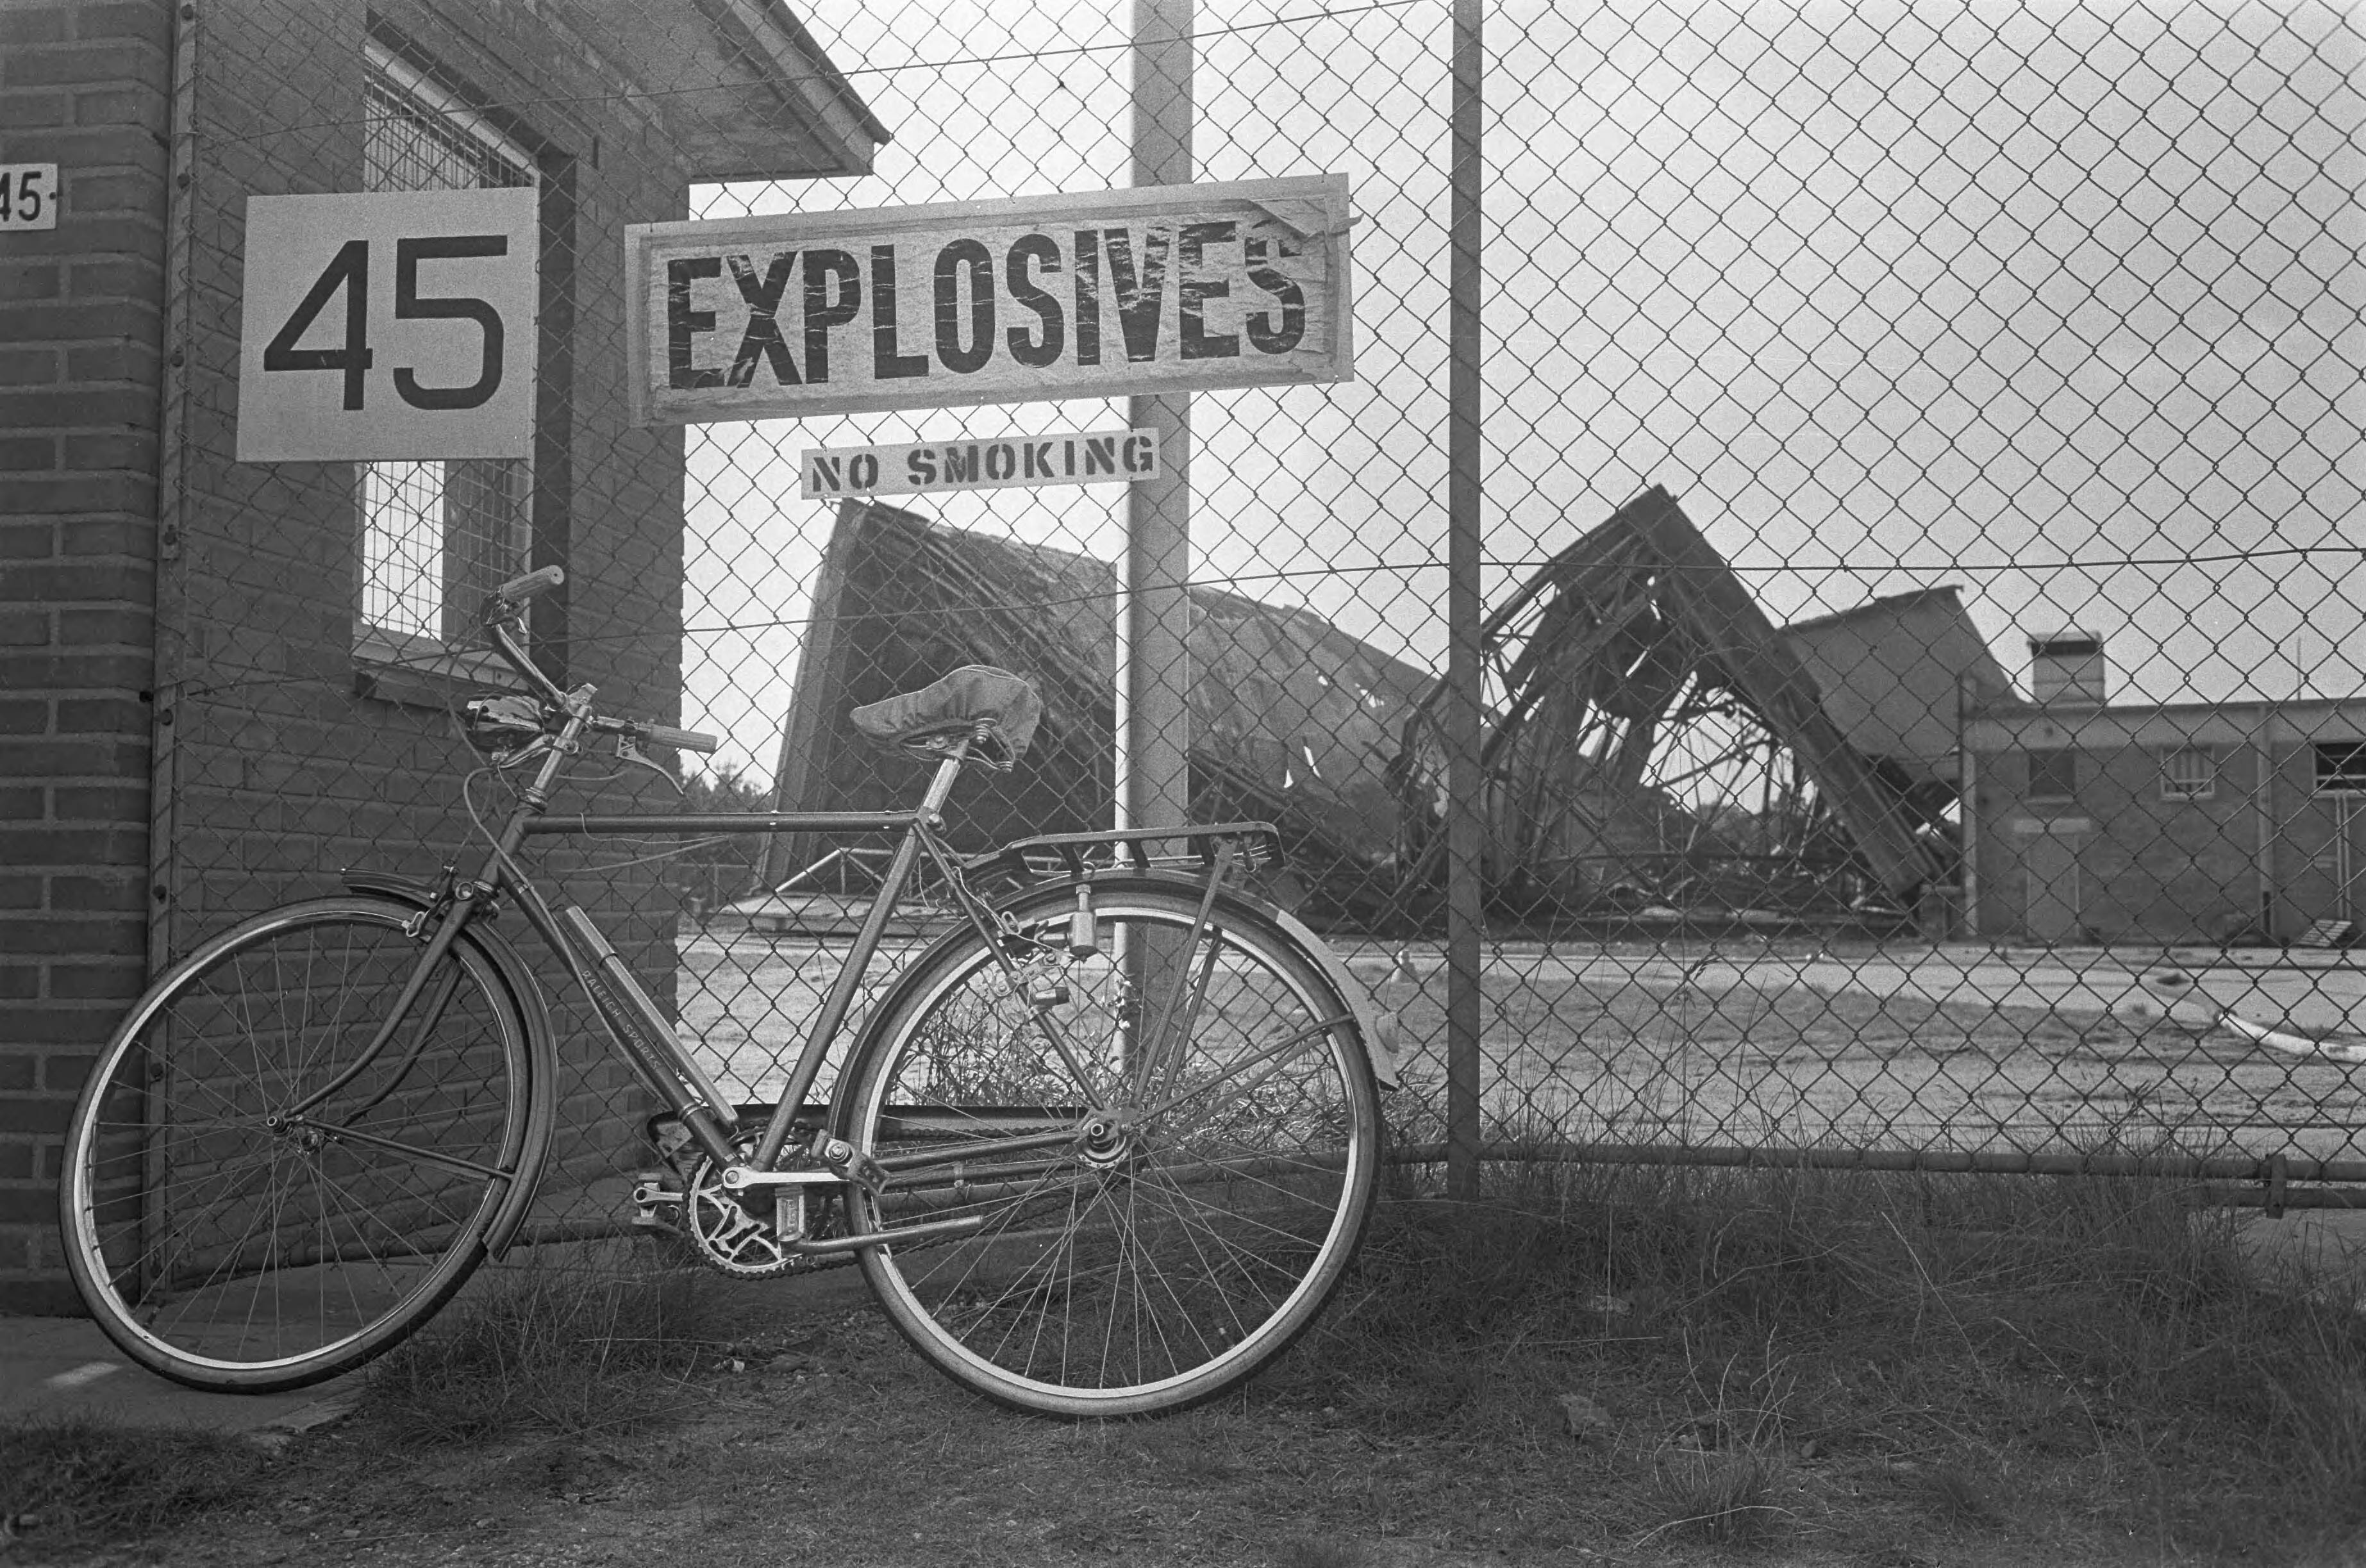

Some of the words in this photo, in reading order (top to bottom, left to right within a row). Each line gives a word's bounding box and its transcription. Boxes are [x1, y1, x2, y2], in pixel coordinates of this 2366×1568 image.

[264, 235, 508, 410] 45
[668, 221, 1305, 389] EXPLOSIVES
[812, 456, 879, 492] NO
[907, 437, 1153, 485] SMOKING
[582, 970, 621, 1017] RALEIGH
[622, 1024, 661, 1070] SPORTS
